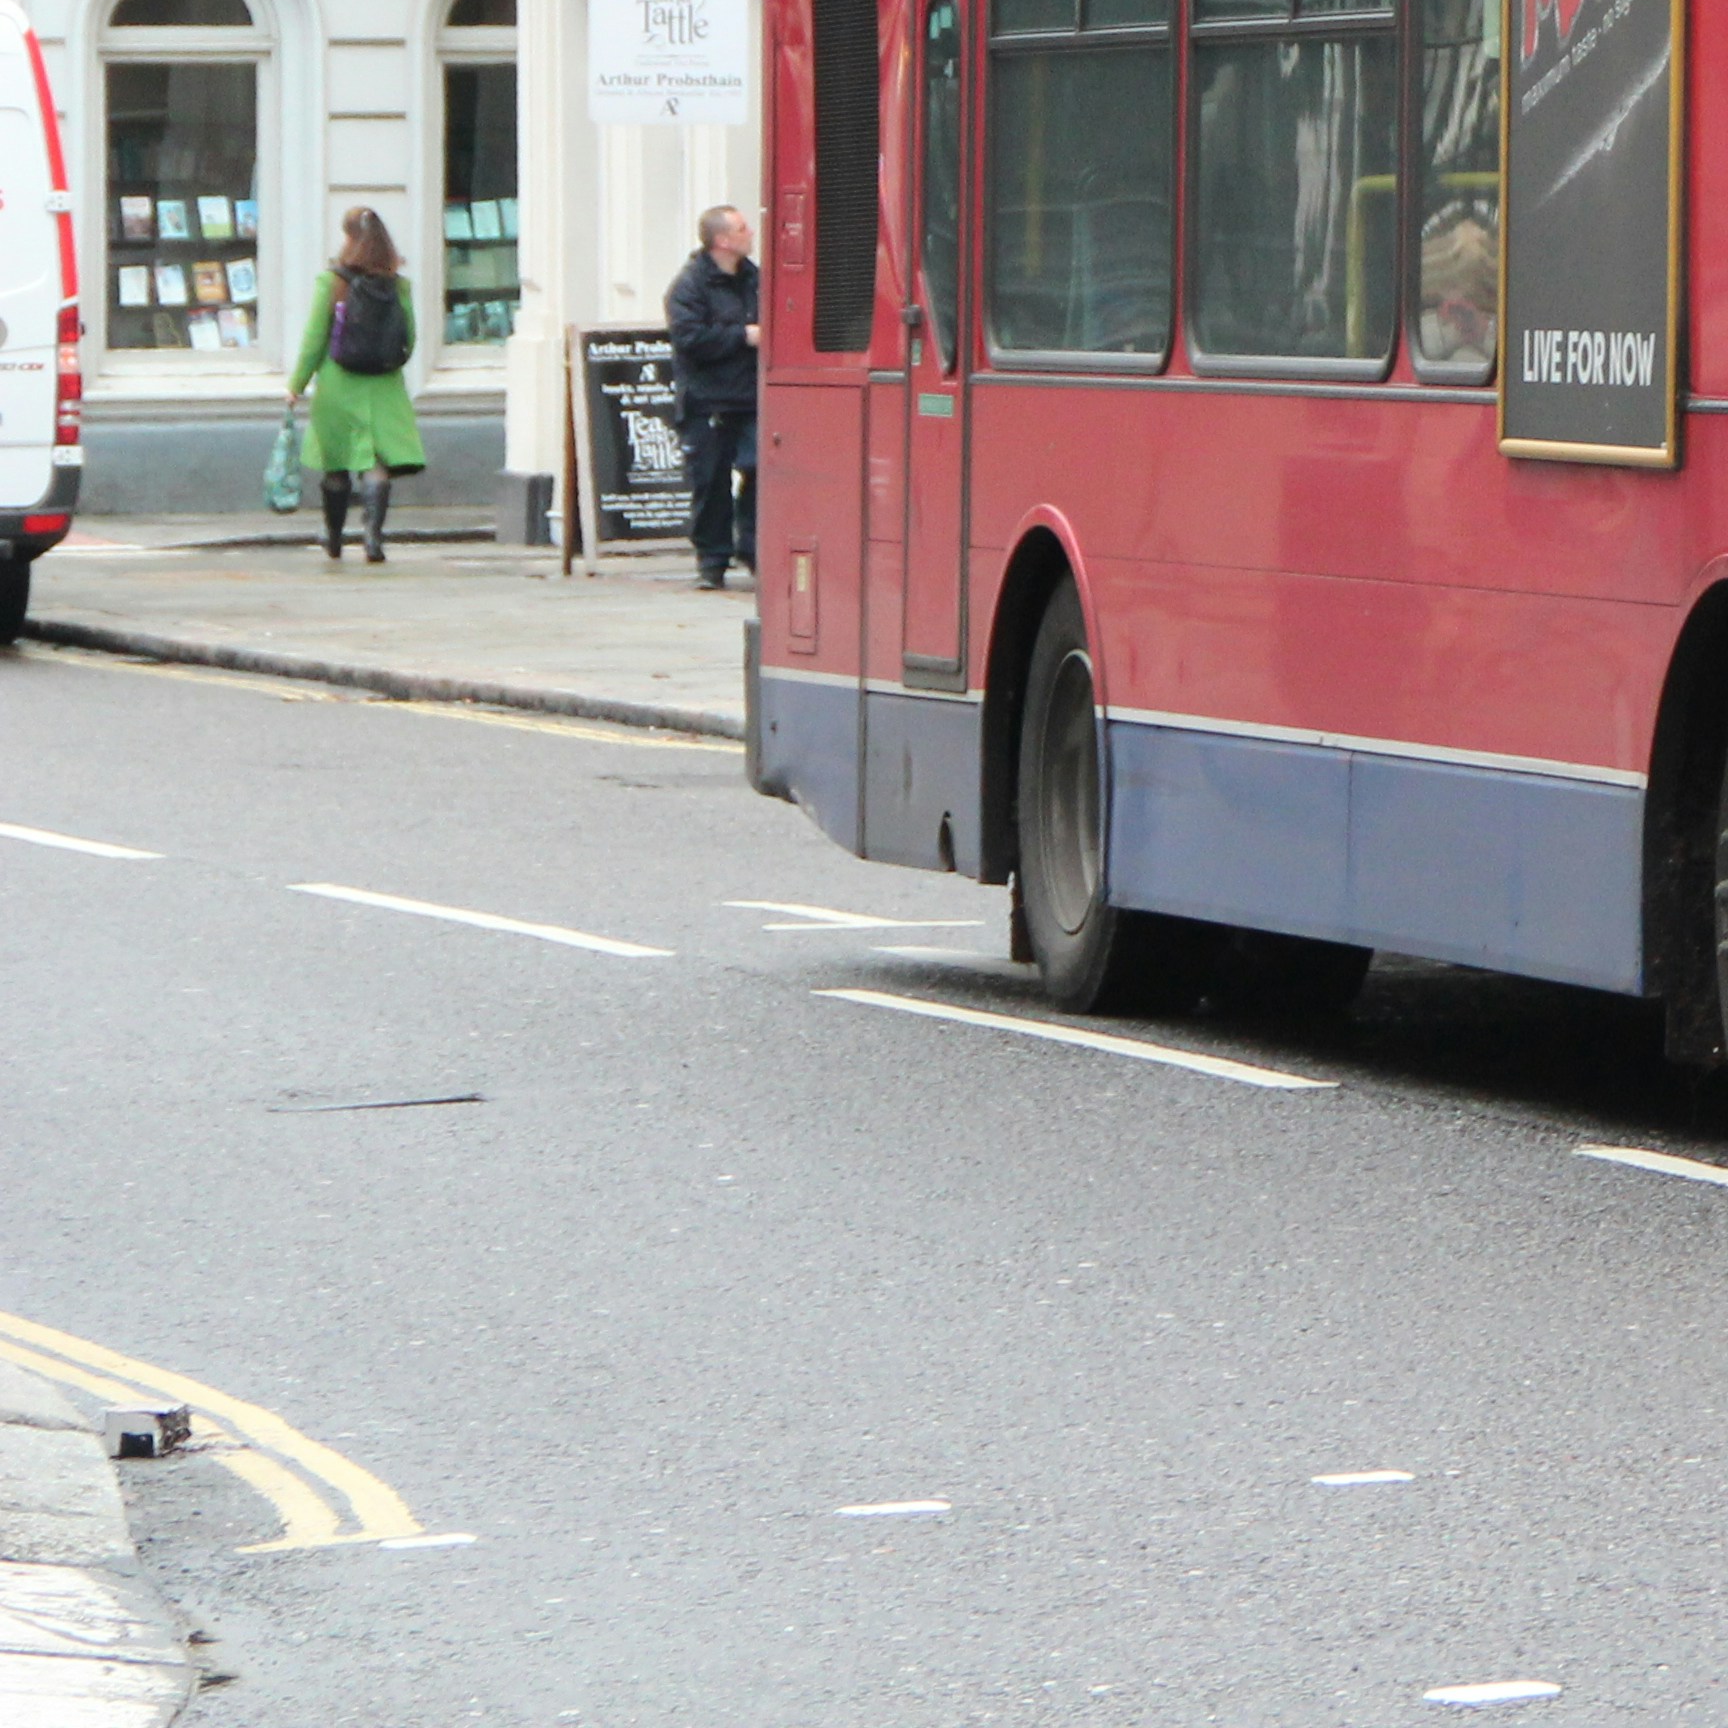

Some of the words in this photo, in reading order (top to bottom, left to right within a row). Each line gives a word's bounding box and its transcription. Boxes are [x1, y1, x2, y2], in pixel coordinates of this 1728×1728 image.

[636, 0, 709, 45] Tattle
[598, 73, 650, 87] Arthur
[1522, 329, 1564, 384] LIVE
[1566, 330, 1606, 385] FOR
[1608, 331, 1656, 387] NOW
[620, 411, 662, 446] Tea
